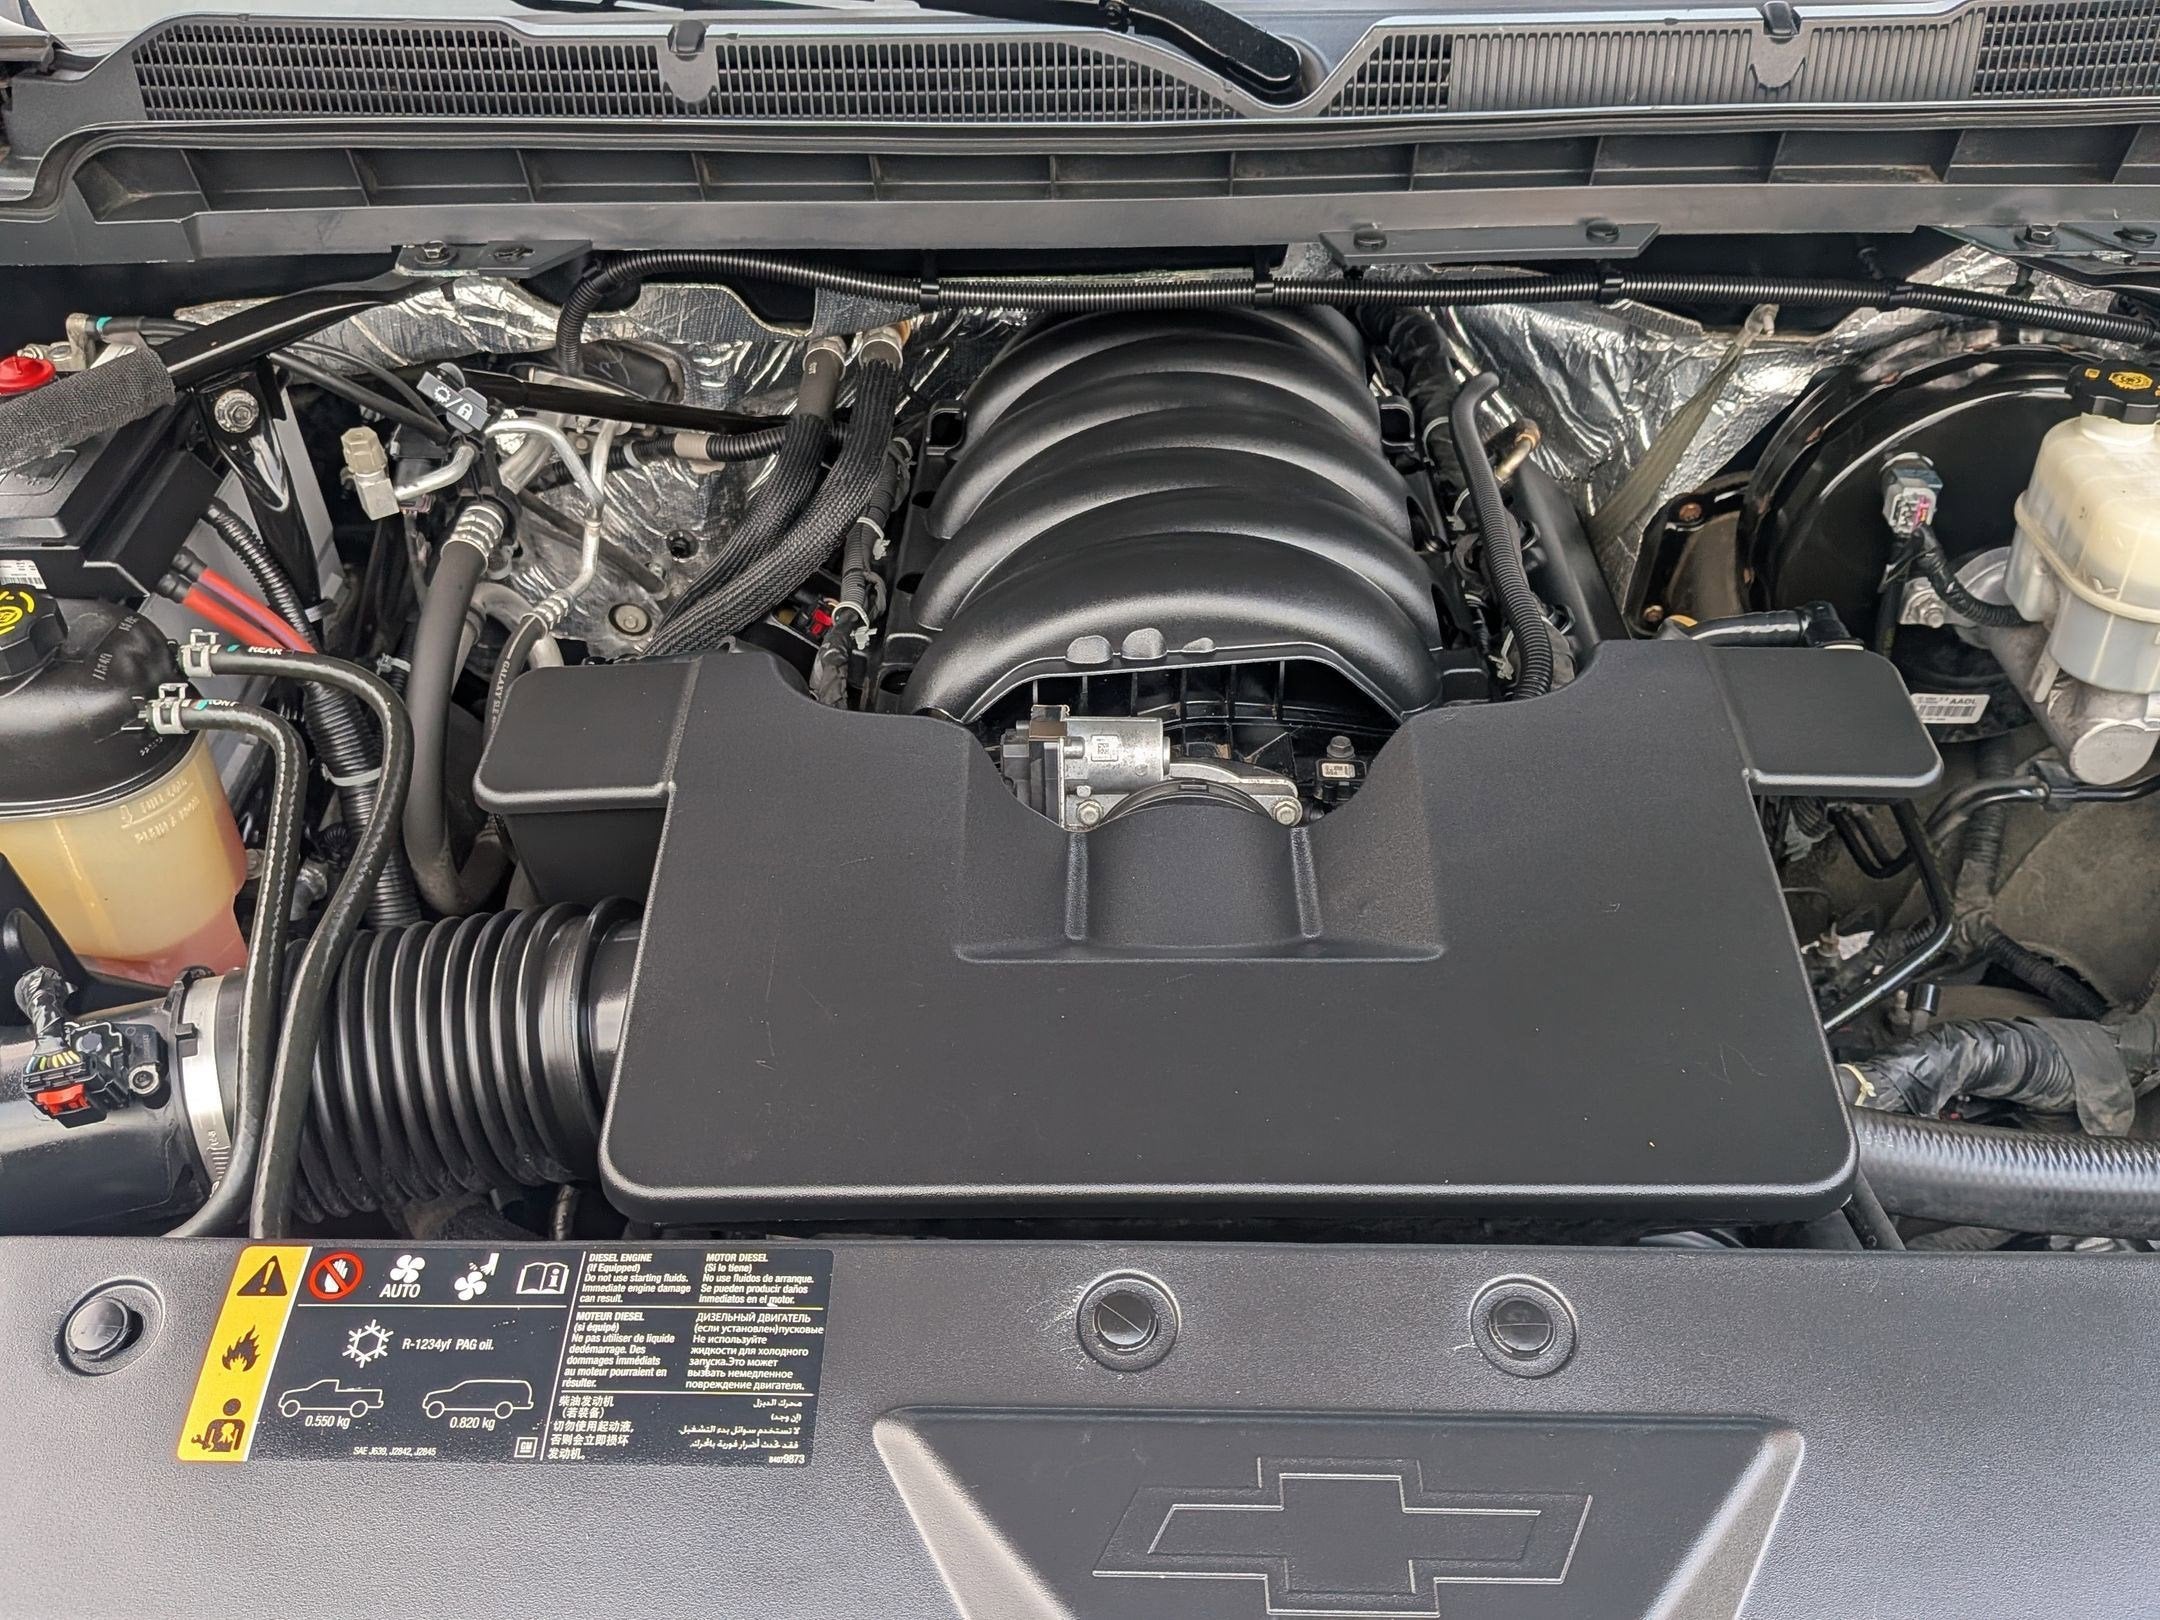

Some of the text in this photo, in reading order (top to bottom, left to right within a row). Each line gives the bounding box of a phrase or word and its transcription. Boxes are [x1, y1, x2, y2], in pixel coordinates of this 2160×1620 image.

[494, 660, 511, 699] GALAXY
[588, 1253, 653, 1262] DIESEL ENGINE
[706, 1253, 769, 1262] MOTOR DIESEL
[586, 1263, 641, 1274] (If Equipped)
[704, 1263, 753, 1273] (Si lo tiene)
[584, 1274, 596, 1282] Do
[597, 1274, 611, 1282] not
[629, 1274, 662, 1284] starting
[663, 1274, 689, 1282] fluids.
[702, 1274, 715, 1282] No
[733, 1274, 761, 1282] fluidos
[762, 1274, 774, 1283] de
[775, 1275, 814, 1285] arranque.
[378, 1283, 421, 1298] AUTO
[581, 1284, 692, 1294] Immediate engine damage
[700, 1284, 809, 1294] Se pueden producir daños
[579, 1294, 623, 1303] can result.
[698, 1294, 745, 1303] inmediatos
[759, 1295, 768, 1304] el
[768, 1295, 795, 1304] motor.
[576, 1312, 645, 1321] MOTEUR DIESEL
[695, 1312, 811, 1323] ДИЗЕЛЬНЫЙ ДВИГАТЕЛЬ
[573, 1323, 620, 1333] (si équipé)
[693, 1323, 720, 1334] (если
[571, 1333, 676, 1344] Ne pas utiliser de liquide
[692, 1335, 768, 1345] Не используйте
[401, 1338, 494, 1352] R-1234yf PAG oil.
[629, 1345, 646, 1354] Des
[690, 1347, 809, 1357] жидкости для холодного
[566, 1356, 661, 1366] dommages immédiats
[747, 1359, 779, 1367] может
[563, 1367, 668, 1378] au moteur pourraient en
[687, 1369, 794, 1379] вызвать немедленное
[561, 1378, 597, 1387] résulter.
[685, 1380, 805, 1391] повреждение двигателя.
[558, 1395, 614, 1407] 柴油发动机
[304, 1415, 351, 1429] 0.550 kg
[449, 1416, 496, 1431] 0.820 kg
[550, 1433, 630, 1447] 否则会立即损坏
[353, 1446, 437, 1456] SAE J639, J2842, J2845
